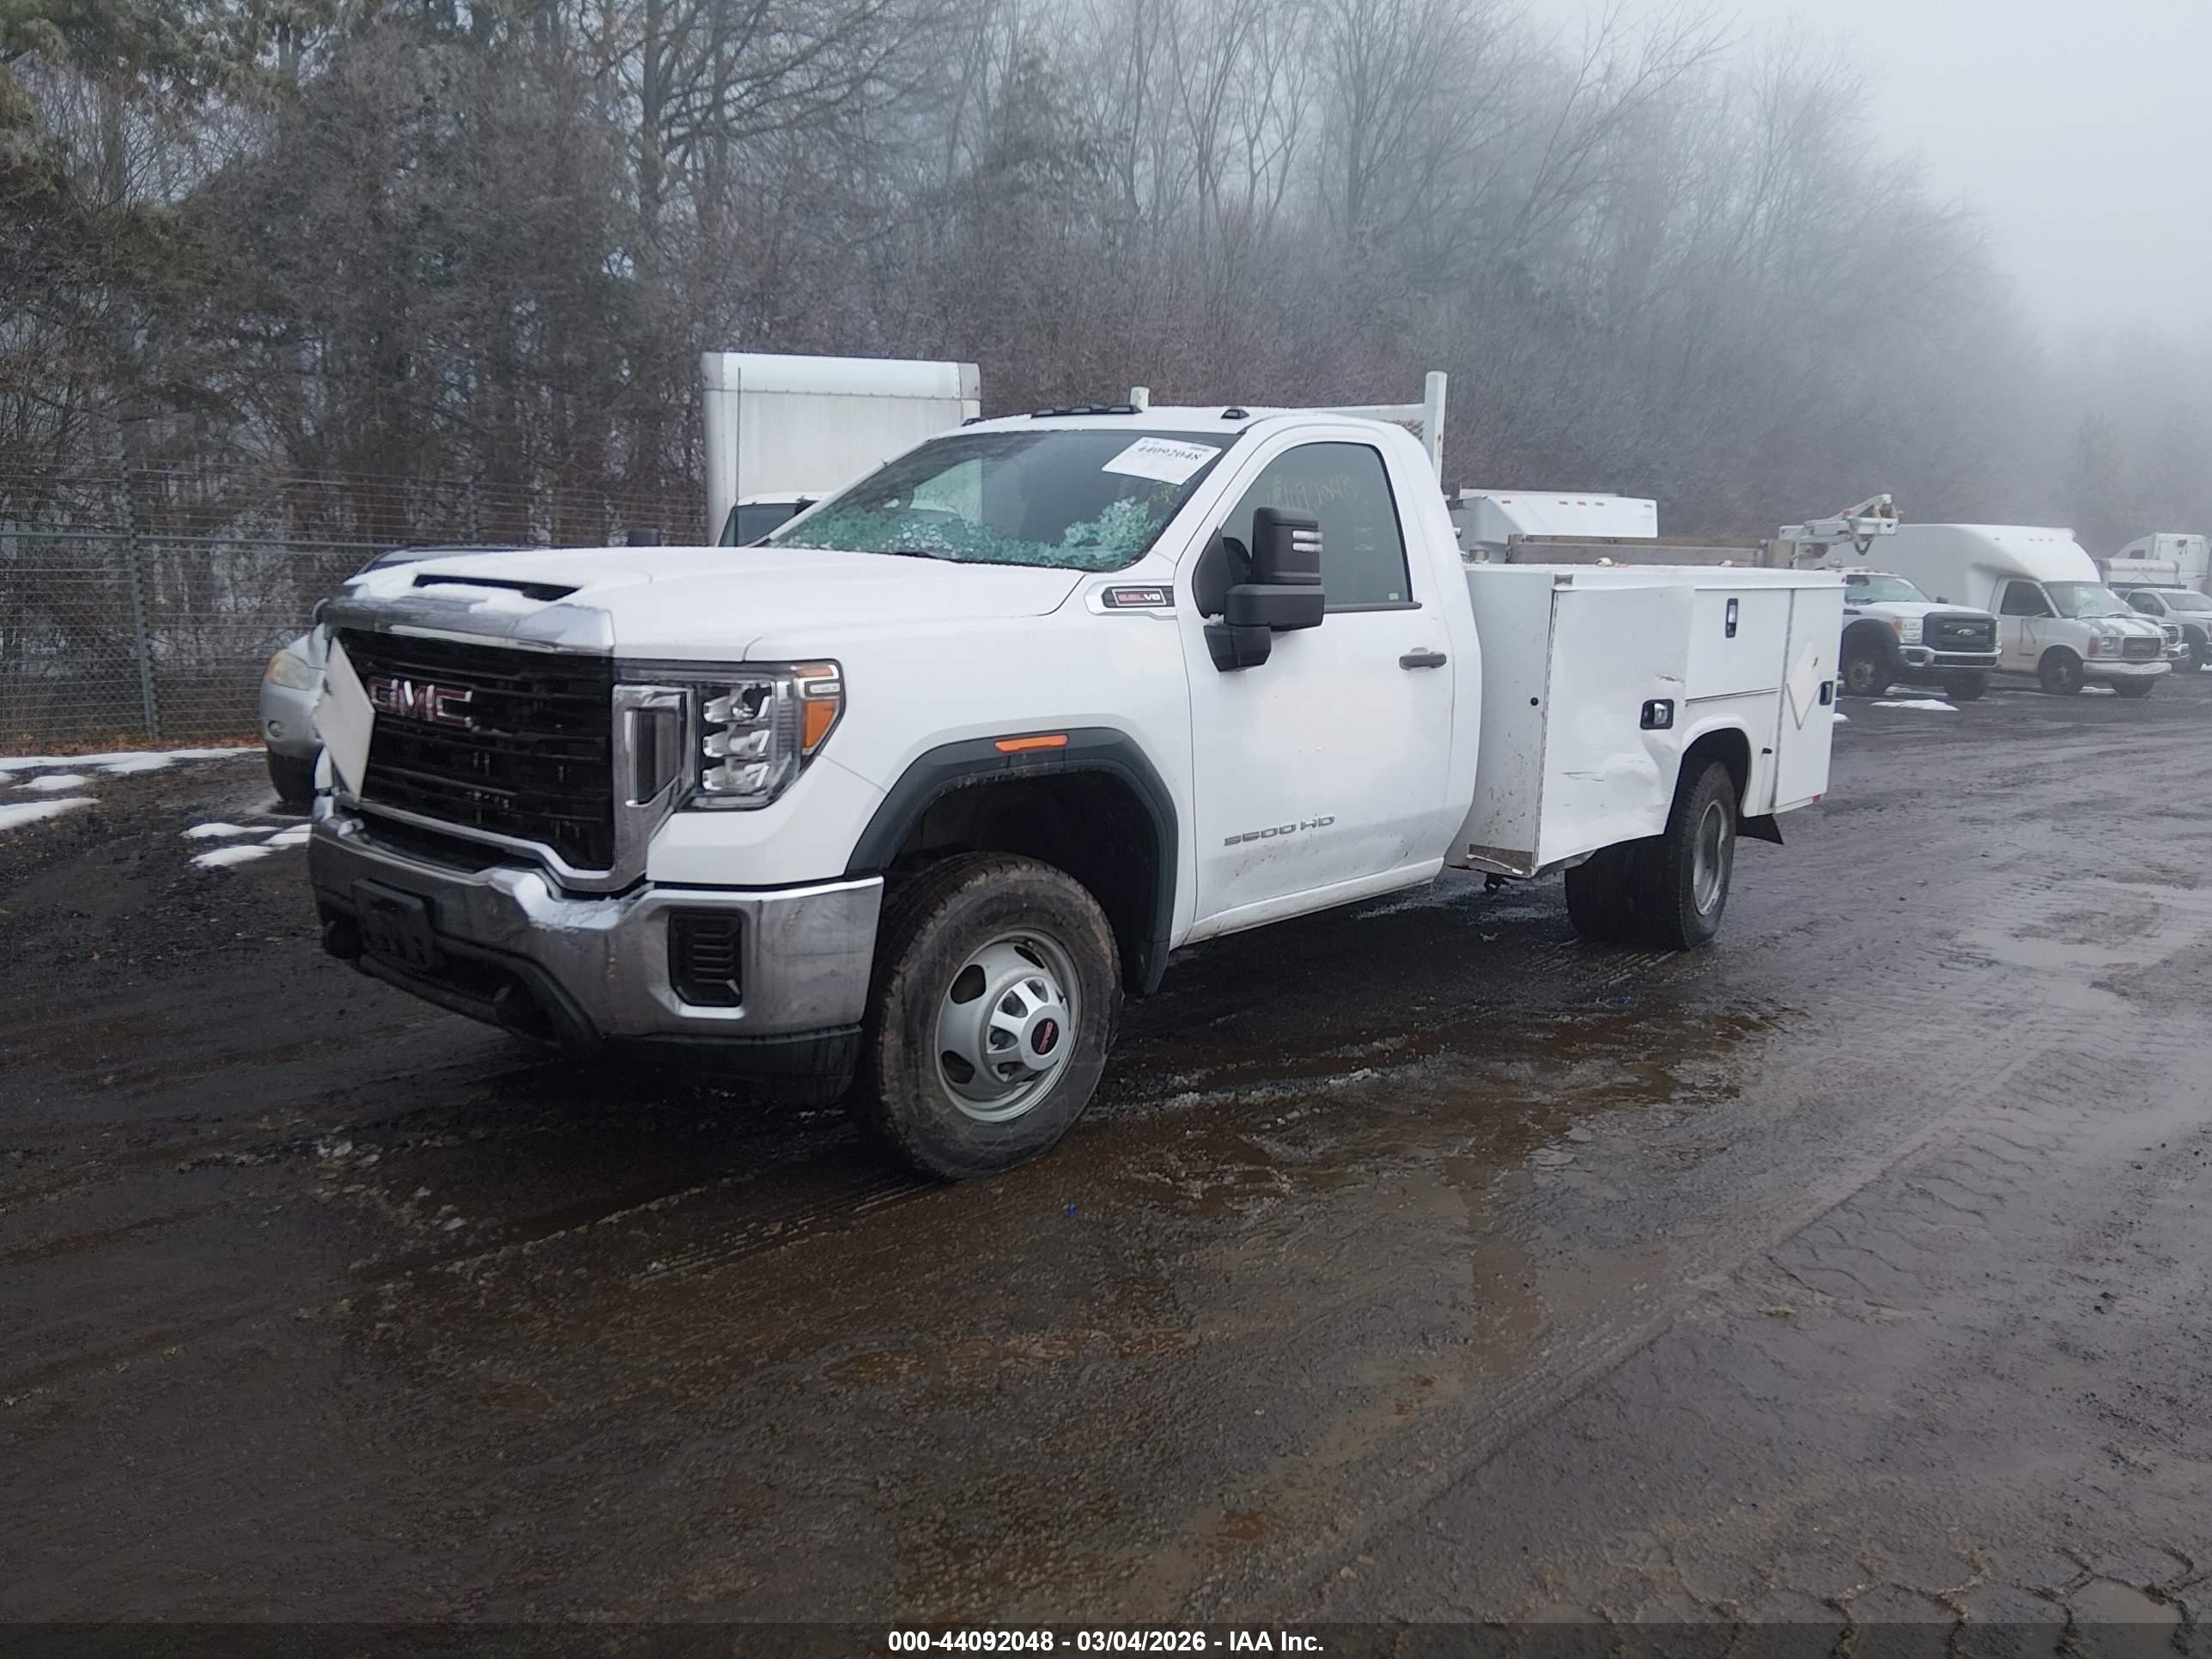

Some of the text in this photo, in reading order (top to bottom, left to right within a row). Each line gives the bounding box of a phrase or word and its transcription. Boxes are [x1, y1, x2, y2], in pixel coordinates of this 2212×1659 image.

[367, 676, 473, 728] GMC
[1224, 815, 1334, 847] 3500 HD
